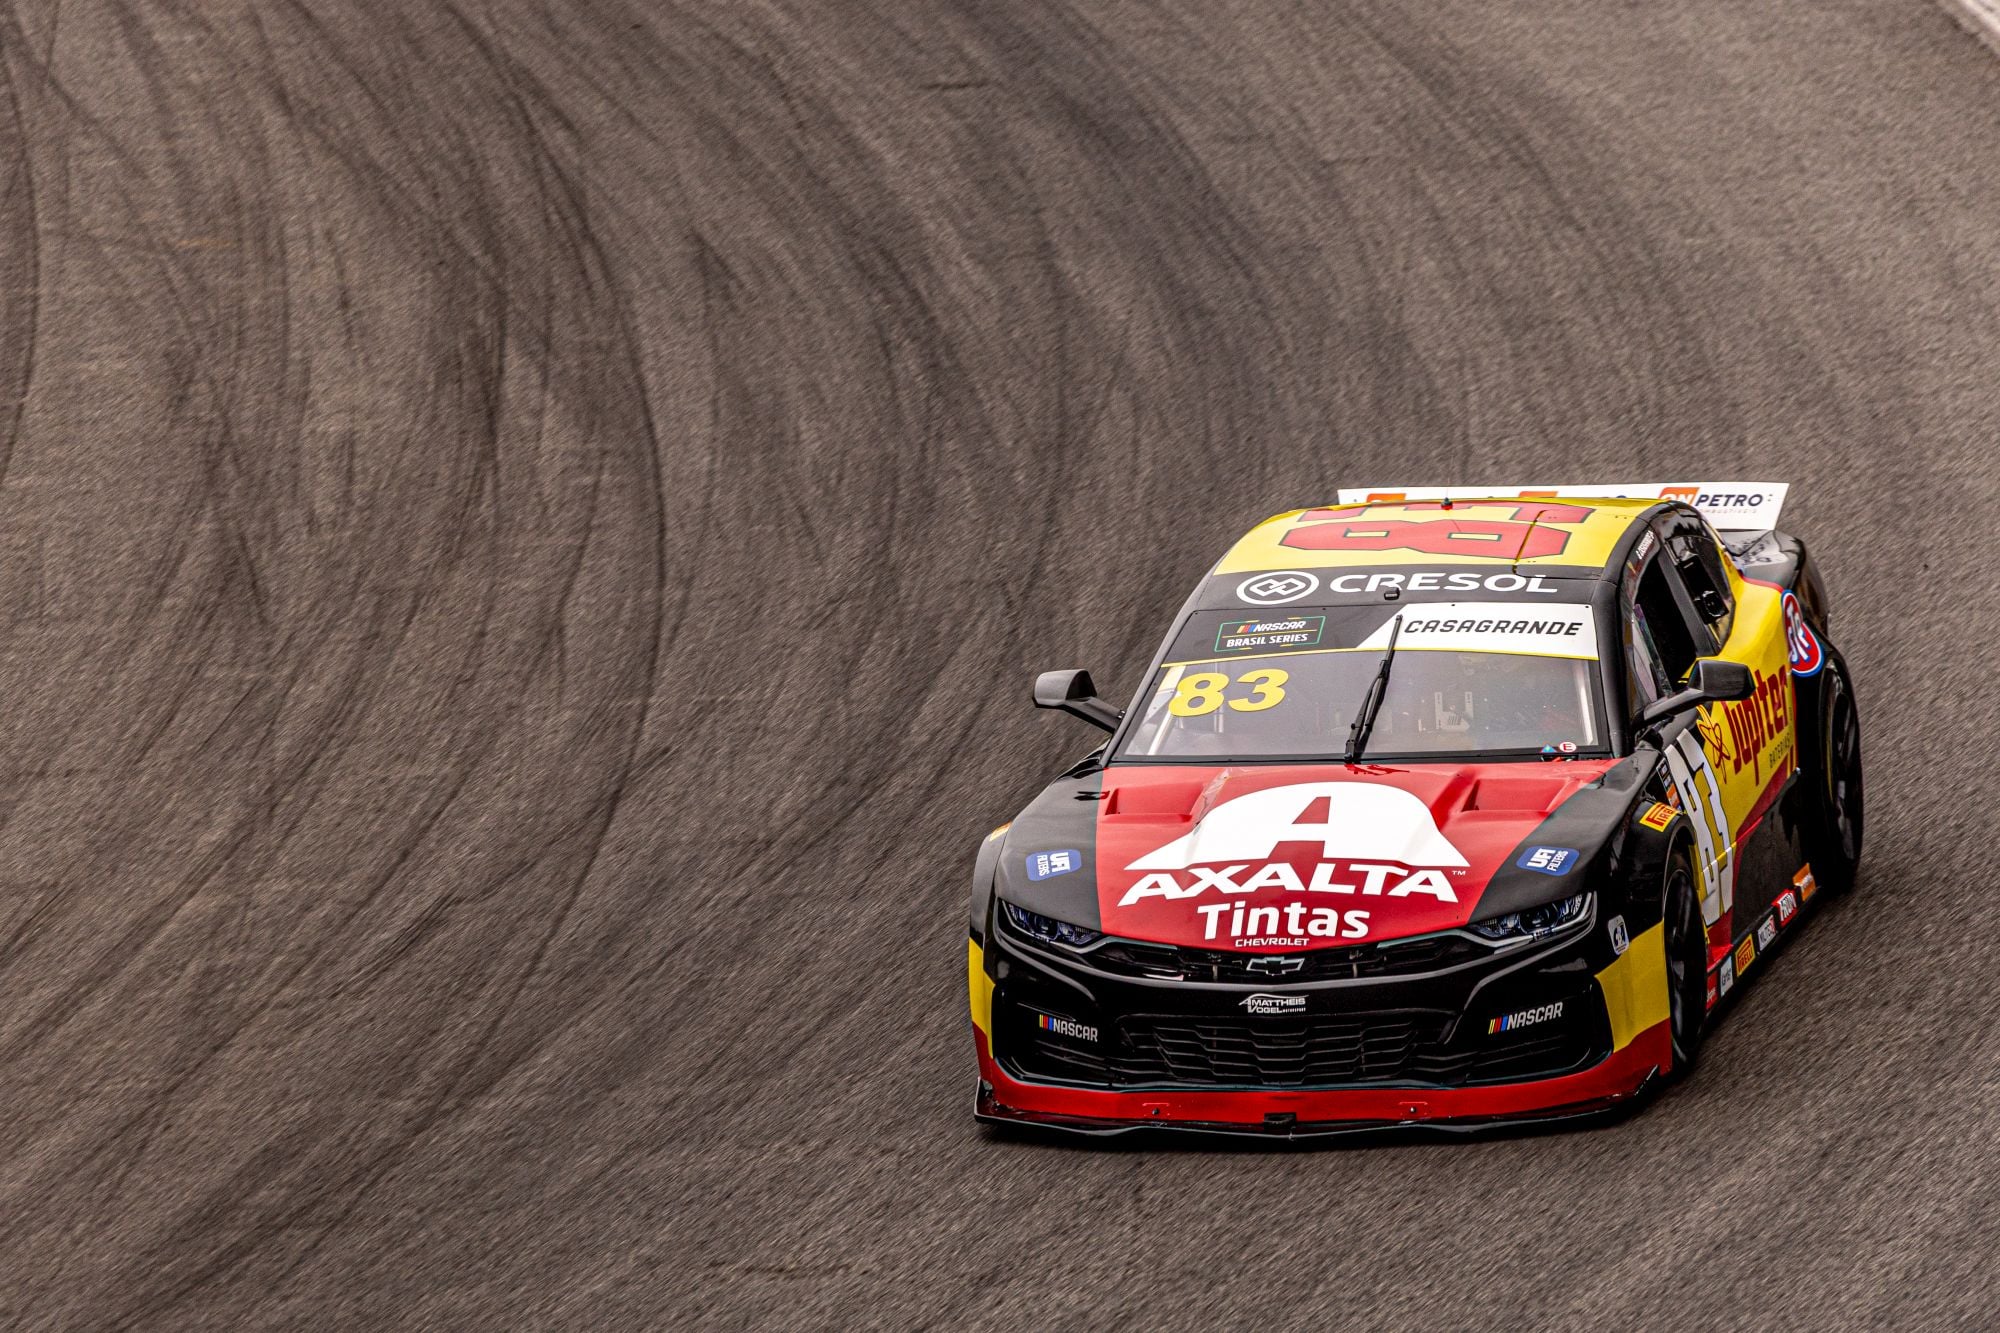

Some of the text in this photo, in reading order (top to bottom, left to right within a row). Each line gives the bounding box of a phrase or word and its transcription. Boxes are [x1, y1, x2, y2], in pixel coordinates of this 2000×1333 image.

[1695, 494, 1763, 507] PETRO
[1330, 572, 1558, 594] CRESOL
[1253, 620, 1307, 633] NASCAR
[1404, 619, 1583, 637] CASAGRANDE
[1226, 633, 1309, 648] BRASIL SERIES
[1168, 668, 1289, 718] 83
[1050, 852, 1071, 873] UFI
[1526, 848, 1557, 869] UFI
[1117, 862, 1459, 907] AXALTA
[1196, 900, 1370, 940] Tintas
[1235, 937, 1310, 948] CHEVROLET
[1507, 1001, 1563, 1030] NASCAR
[1053, 1018, 1099, 1043] NASCAR
